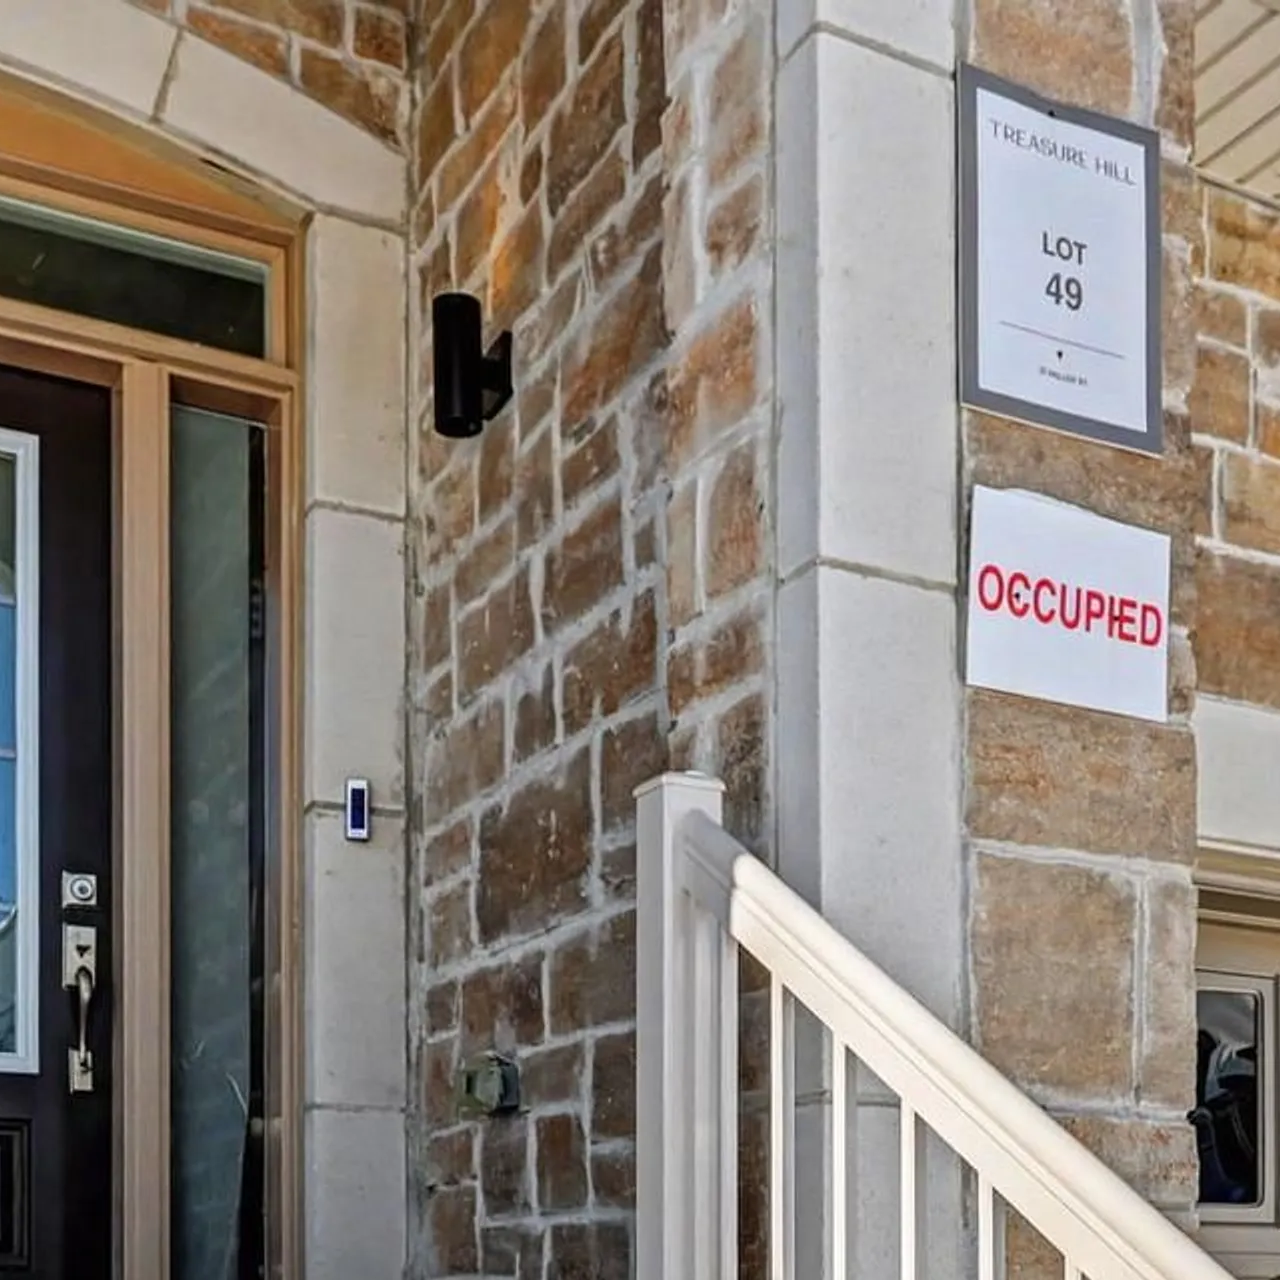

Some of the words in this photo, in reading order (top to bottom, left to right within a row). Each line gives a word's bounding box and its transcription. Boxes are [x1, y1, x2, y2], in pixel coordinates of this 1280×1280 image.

[990, 118, 1088, 169] TREASURE
[1094, 156, 1137, 186] HILL
[1042, 231, 1088, 265] LOT
[1045, 272, 1083, 311] 49
[977, 564, 1163, 648] OCCUPIED
